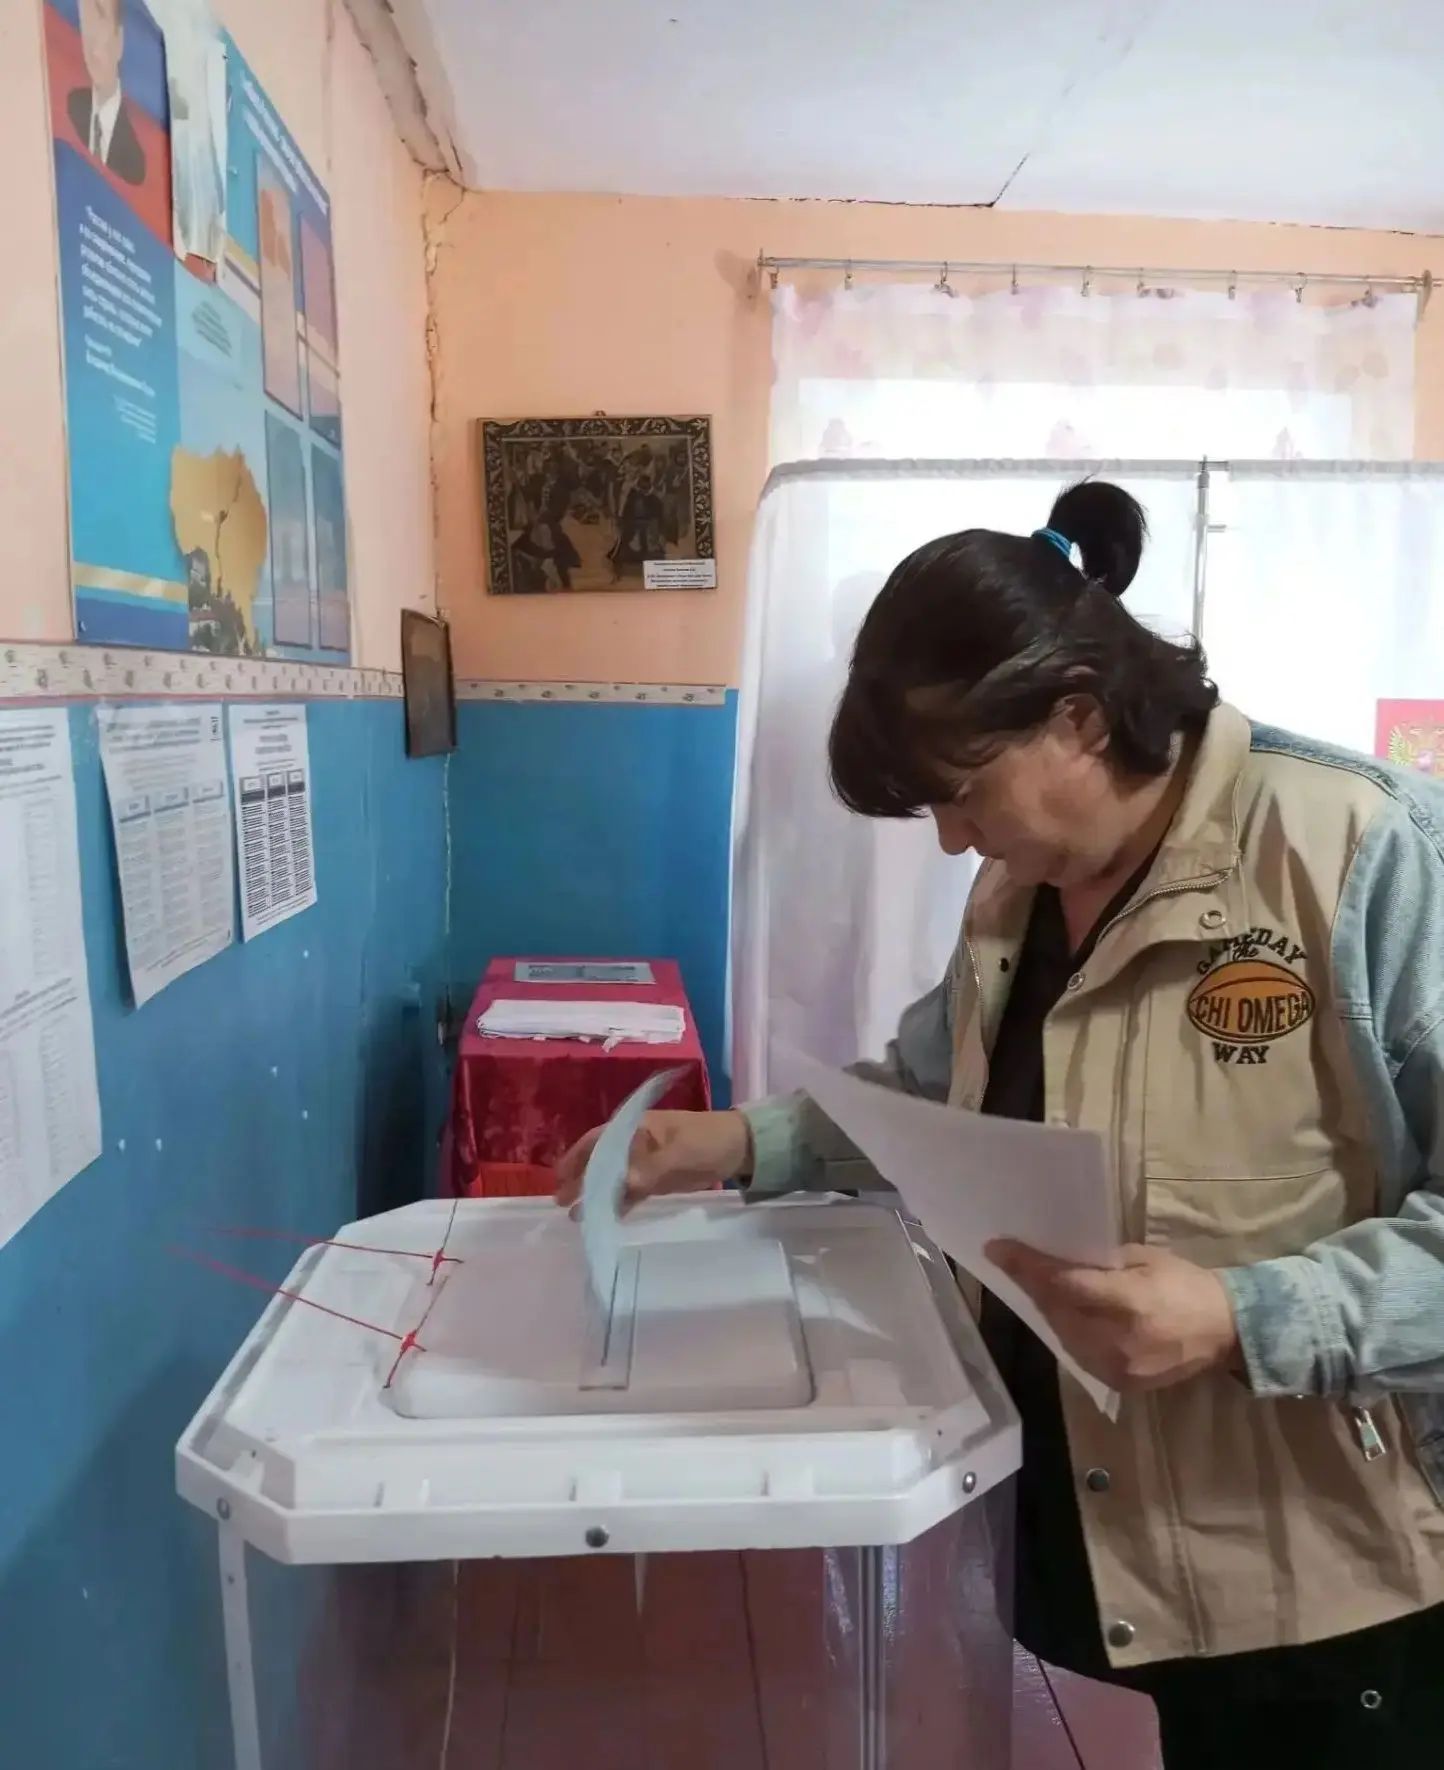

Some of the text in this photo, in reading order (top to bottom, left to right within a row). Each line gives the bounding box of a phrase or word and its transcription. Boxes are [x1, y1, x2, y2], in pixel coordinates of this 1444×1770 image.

[1194, 991, 1309, 1034] CHI OMEGA
[1212, 1042, 1270, 1064] WAY
